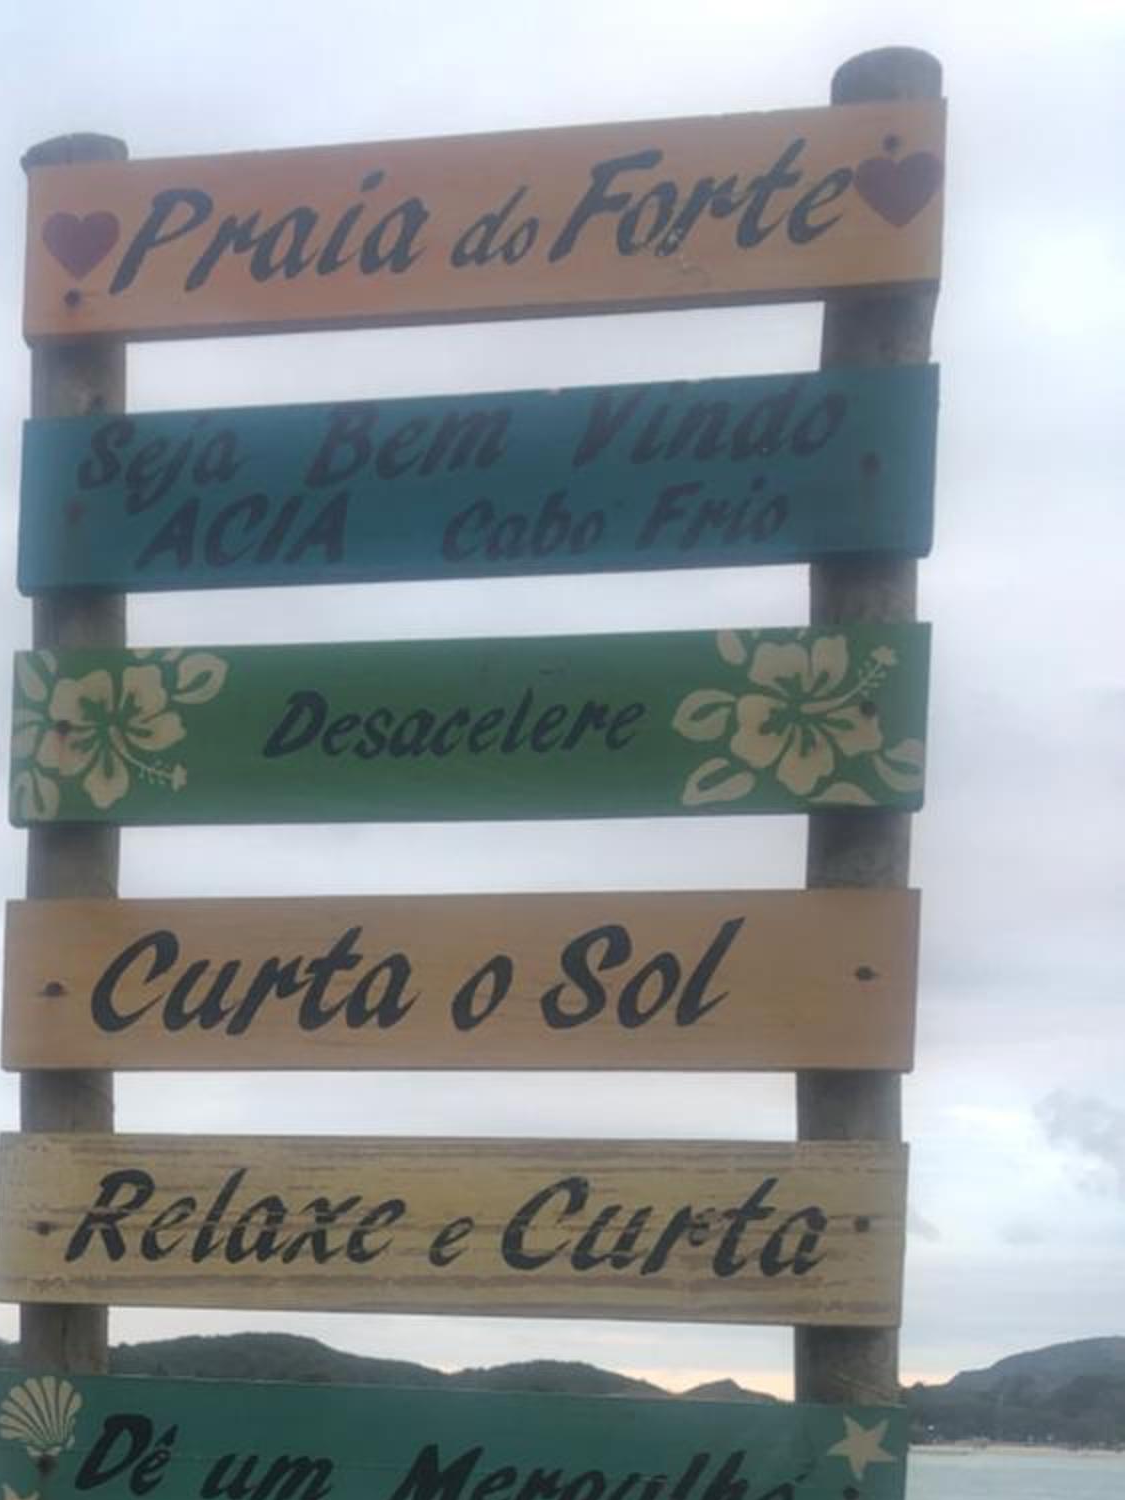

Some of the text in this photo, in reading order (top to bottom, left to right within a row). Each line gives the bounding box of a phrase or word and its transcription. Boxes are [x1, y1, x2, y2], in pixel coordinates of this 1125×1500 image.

[108, 139, 854, 296] Praia do Forte
[77, 388, 847, 514] Seja Bem Vindo
[136, 476, 789, 571] ACIA Cabo Frio
[264, 690, 646, 761] Desacelere
[91, 917, 745, 1035] Curta o Sol
[65, 1167, 825, 1277] Relaxe e Curta
[78, 1415, 179, 1495] Dê
